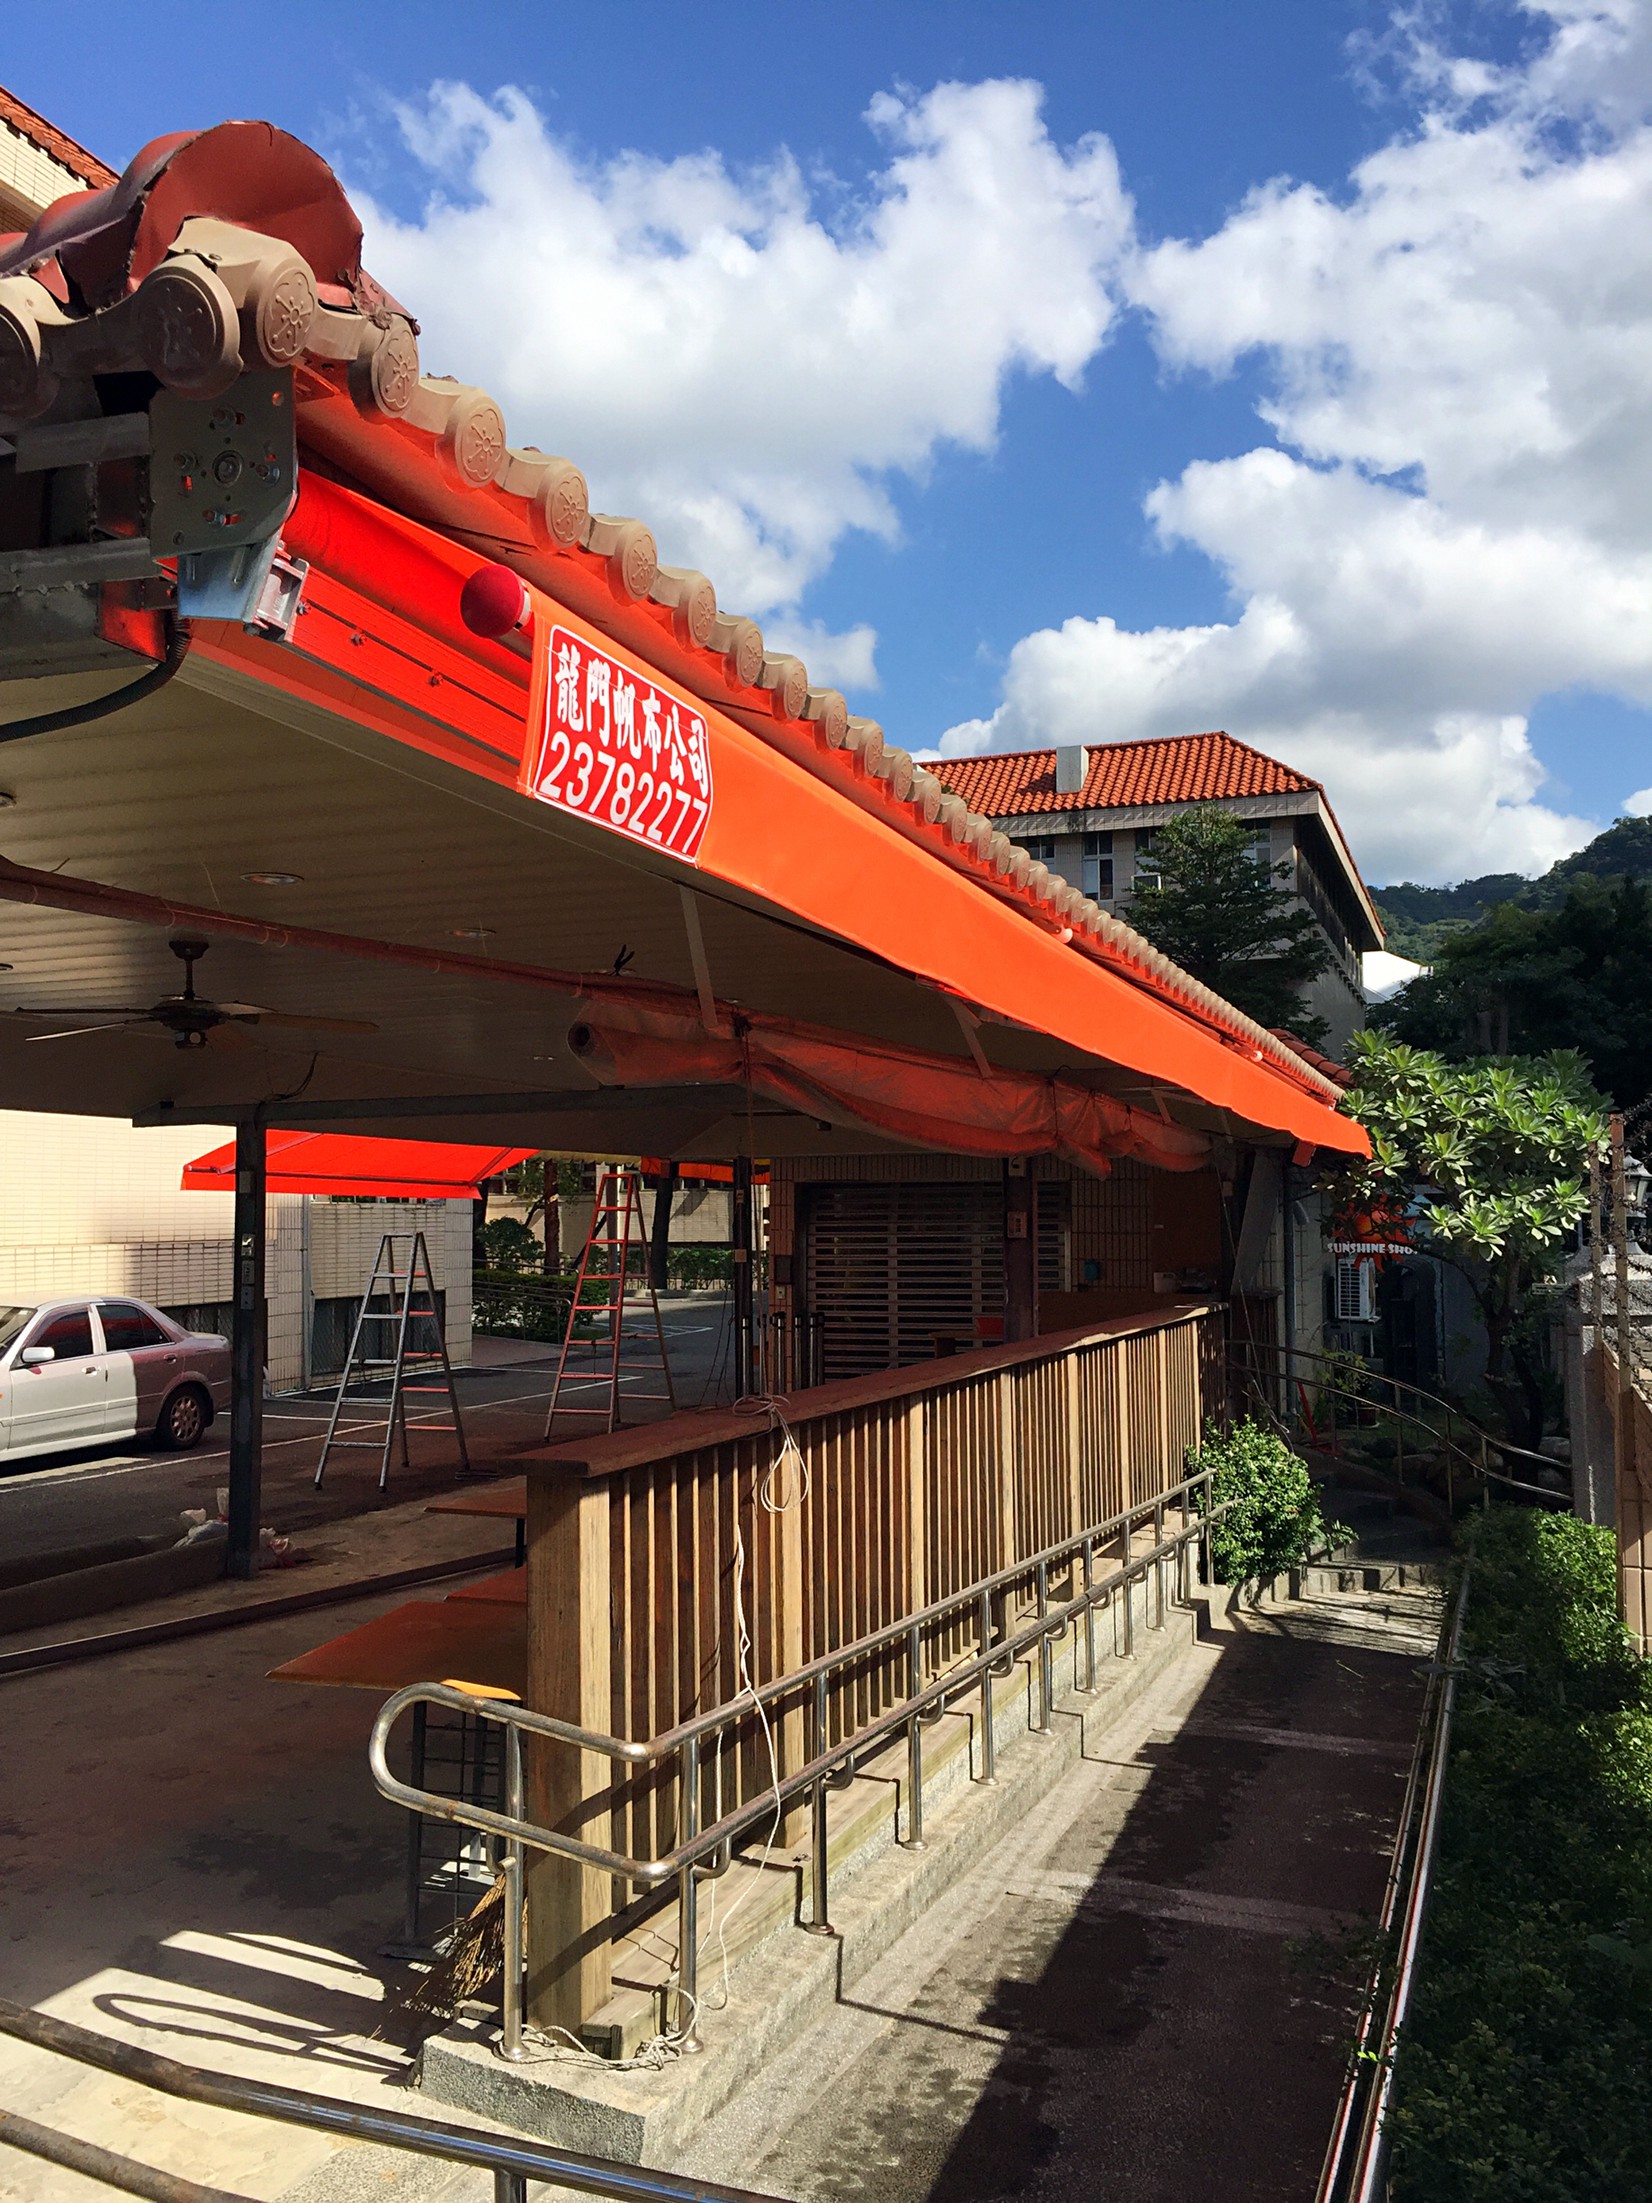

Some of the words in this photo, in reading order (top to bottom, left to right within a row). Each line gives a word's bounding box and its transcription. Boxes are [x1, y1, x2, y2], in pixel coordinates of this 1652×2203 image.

[554, 642, 708, 799] 龍門帆布公司
[539, 731, 708, 854] 23782277
[1327, 1242, 1386, 1254] SUNSHINE
[1388, 1243, 1418, 1255] SHO
